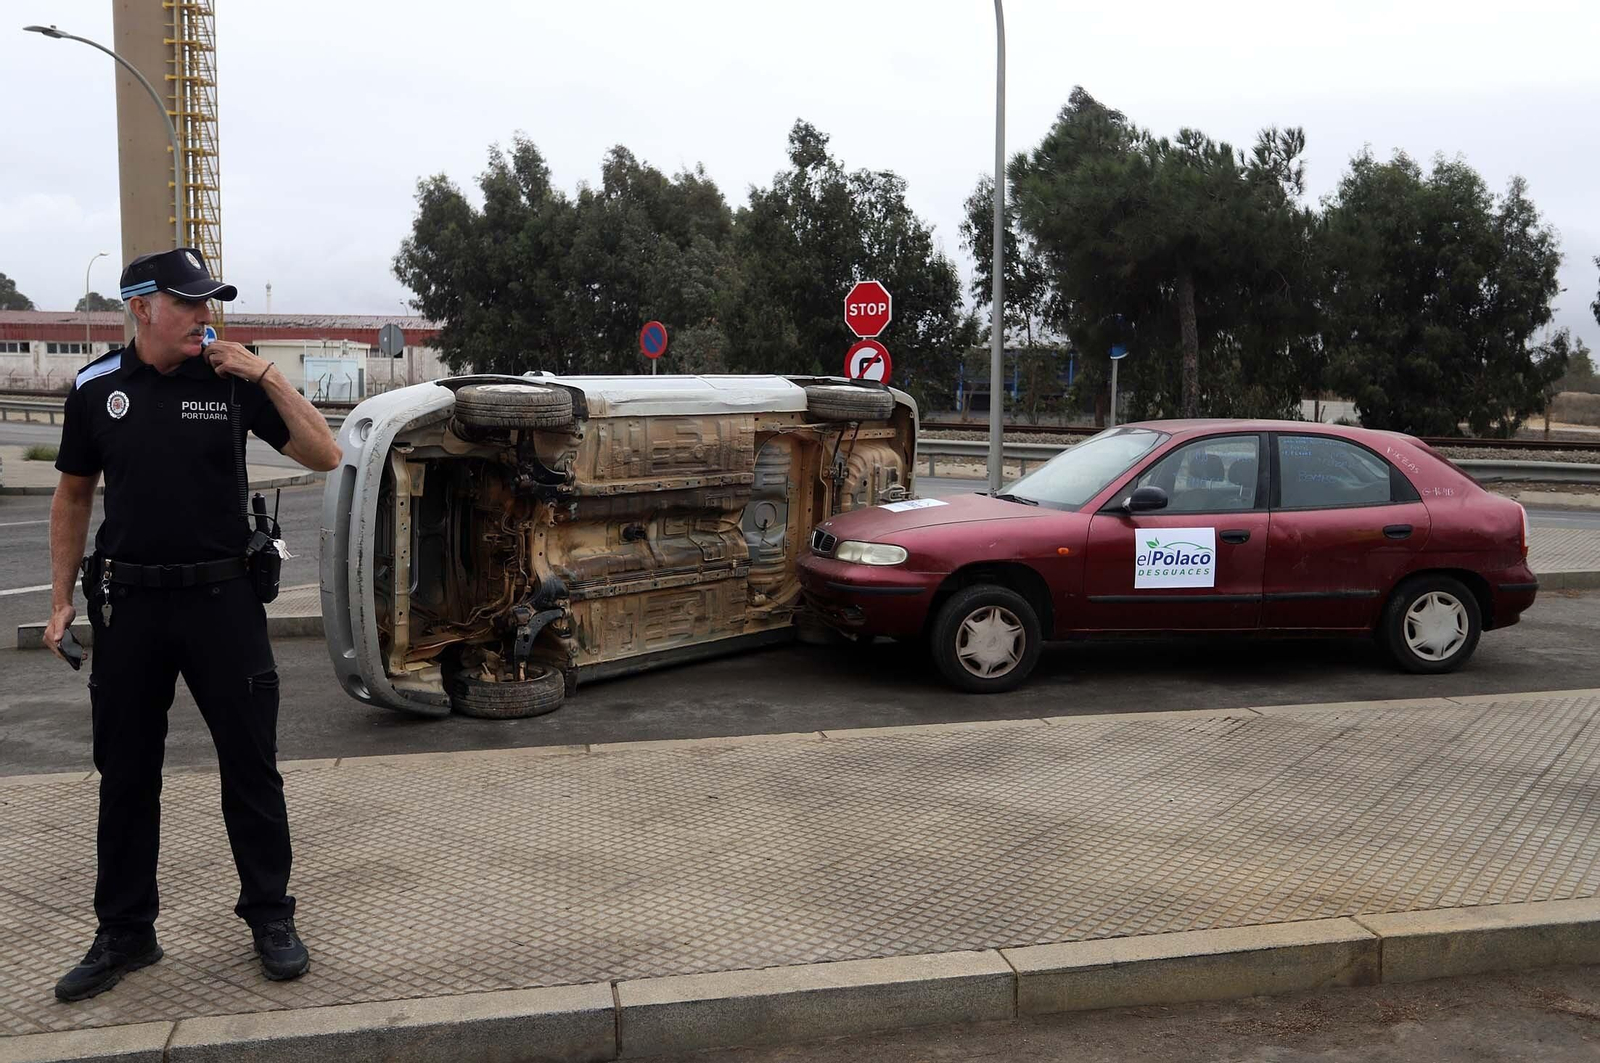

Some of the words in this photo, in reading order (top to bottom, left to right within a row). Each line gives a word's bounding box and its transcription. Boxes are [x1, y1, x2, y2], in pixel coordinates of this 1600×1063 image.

[849, 302, 887, 316] STOP
[181, 401, 228, 412] POLICIA
[181, 412, 228, 420] PORTUARIA
[1137, 549, 1211, 566] elPolaco
[1138, 568, 1210, 576] DESGUACES
